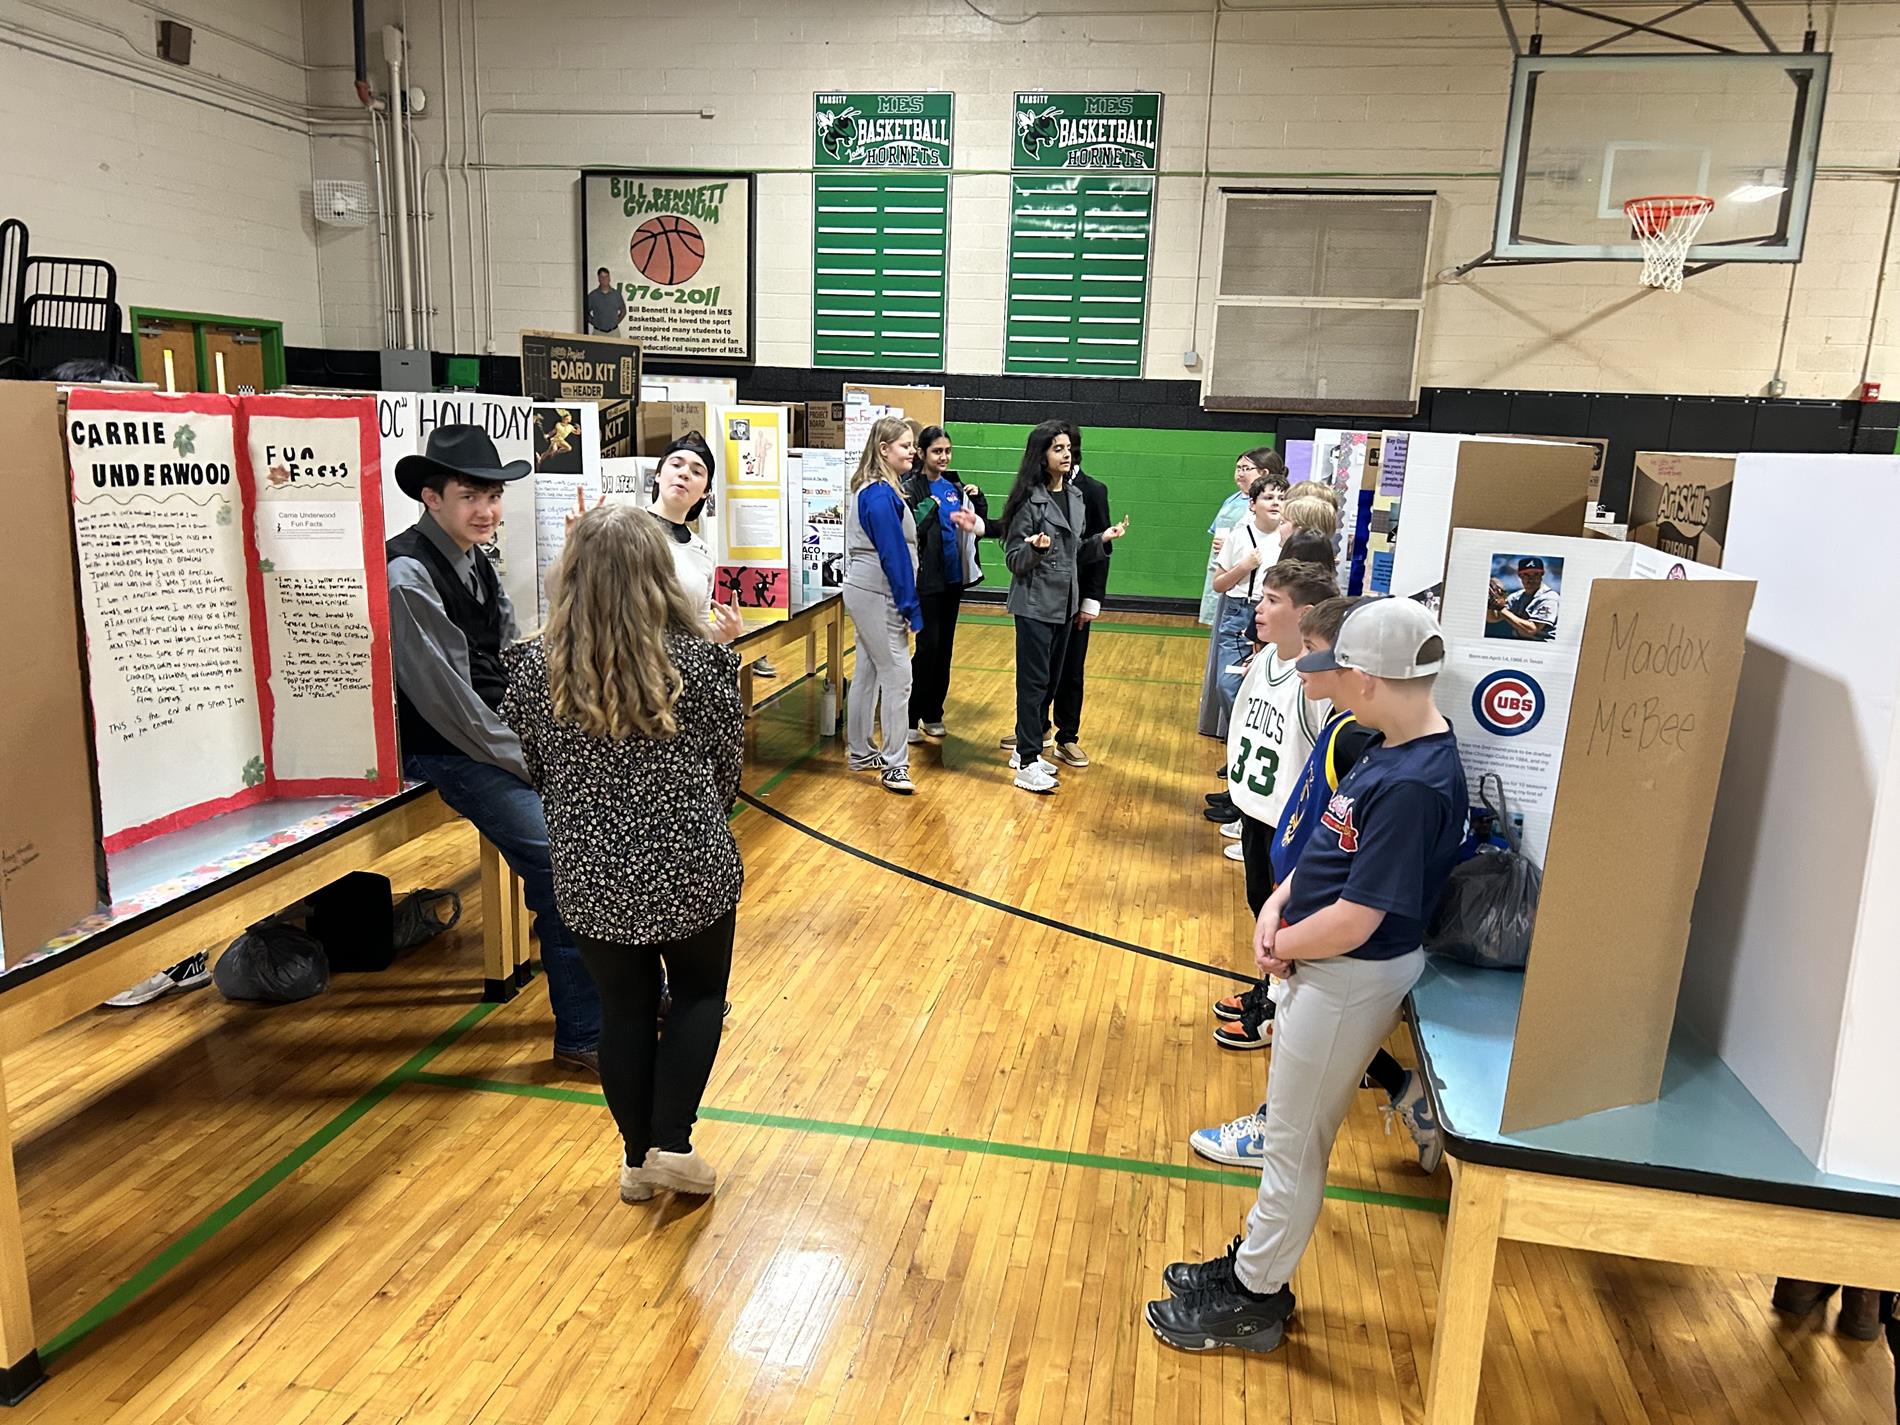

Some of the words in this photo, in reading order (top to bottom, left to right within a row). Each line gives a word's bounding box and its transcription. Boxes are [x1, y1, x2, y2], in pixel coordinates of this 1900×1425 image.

[819, 95, 848, 104] VARSITY
[878, 95, 924, 114] MES
[1019, 95, 1049, 104] VARSITY
[1084, 97, 1133, 115] MES
[858, 118, 950, 146] BASKETBALL
[1058, 118, 1156, 148] BASKETBALL
[865, 146, 940, 165] HORNETS
[1067, 147, 1145, 168] HORNETS
[610, 177, 647, 200] BILL
[652, 183, 728, 204] BENNETT
[623, 200, 719, 224] GYMNASIUM
[616, 282, 720, 307] 1976-2011
[628, 315, 666, 323] Basketball.
[668, 316, 678, 324] He
[679, 317, 698, 325] loved
[712, 318, 731, 327] sport
[683, 308, 708, 317] legend
[642, 325, 671, 335] inspired
[672, 327, 691, 336] many
[692, 327, 721, 335] students
[723, 327, 731, 335] to
[711, 336, 726, 344] avid
[643, 344, 682, 352] educational
[684, 346, 717, 354] supporter
[551, 360, 593, 380] BOARD
[596, 363, 615, 381] KIT
[573, 385, 601, 397] HEADER
[809, 410, 828, 418] PROJECT
[71, 420, 165, 449] CARRIE
[605, 417, 624, 441] KIT
[266, 444, 314, 465] Fun
[600, 447, 616, 459] DER
[92, 463, 230, 487] UNDERWOOD
[290, 462, 348, 482] Facts
[1603, 612, 1710, 682] Maddox
[1245, 697, 1284, 745] ELTICS
[1230, 736, 1280, 797] 33
